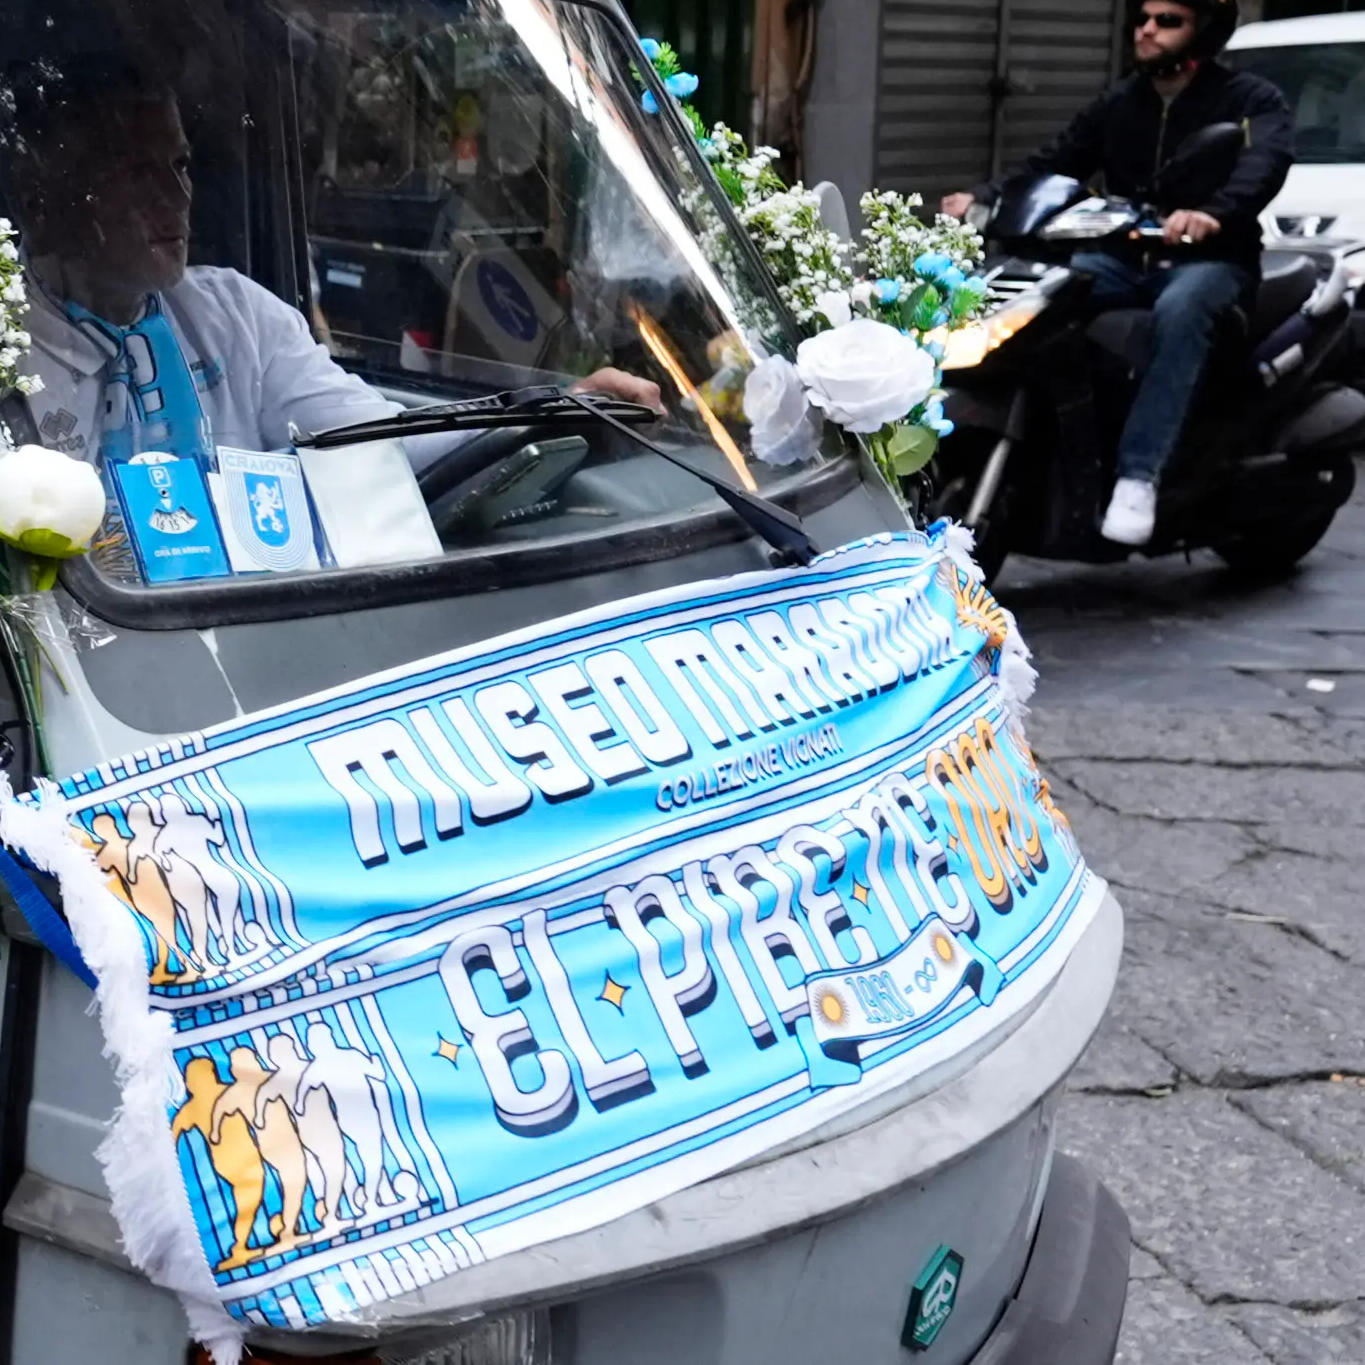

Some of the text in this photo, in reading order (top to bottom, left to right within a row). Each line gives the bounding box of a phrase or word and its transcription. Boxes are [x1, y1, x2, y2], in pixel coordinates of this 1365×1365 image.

[152, 469, 165, 485] P
[225, 454, 295, 474] CRAIOVA
[305, 575, 972, 869] MUSEO MARADONA
[656, 744, 782, 812] COLLEZIONE
[437, 908, 656, 1138] EL
[602, 824, 882, 1081] PIBE
[925, 717, 1049, 916] ORO
